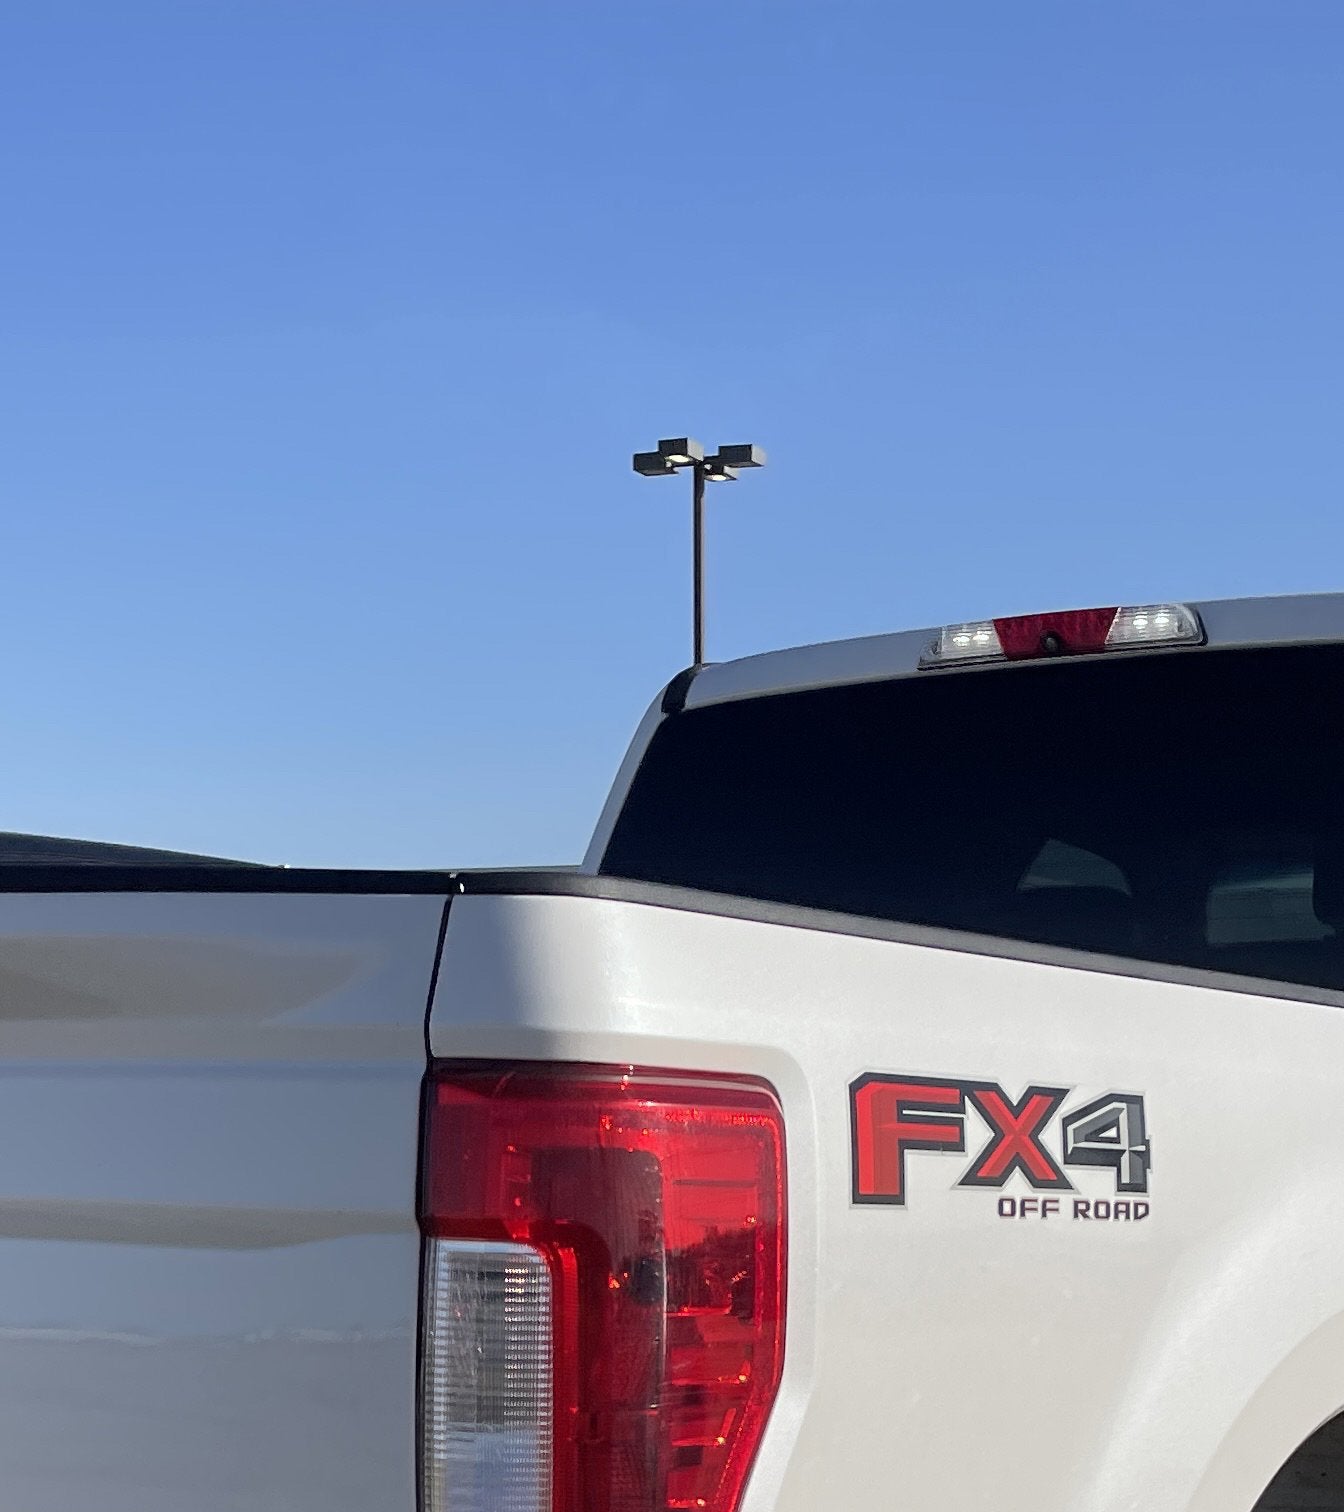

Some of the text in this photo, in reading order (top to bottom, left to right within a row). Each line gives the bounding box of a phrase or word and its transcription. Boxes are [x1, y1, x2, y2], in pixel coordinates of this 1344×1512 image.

[848, 1071, 1151, 1205] FX4
[997, 1197, 1150, 1222] OFF ROAD
